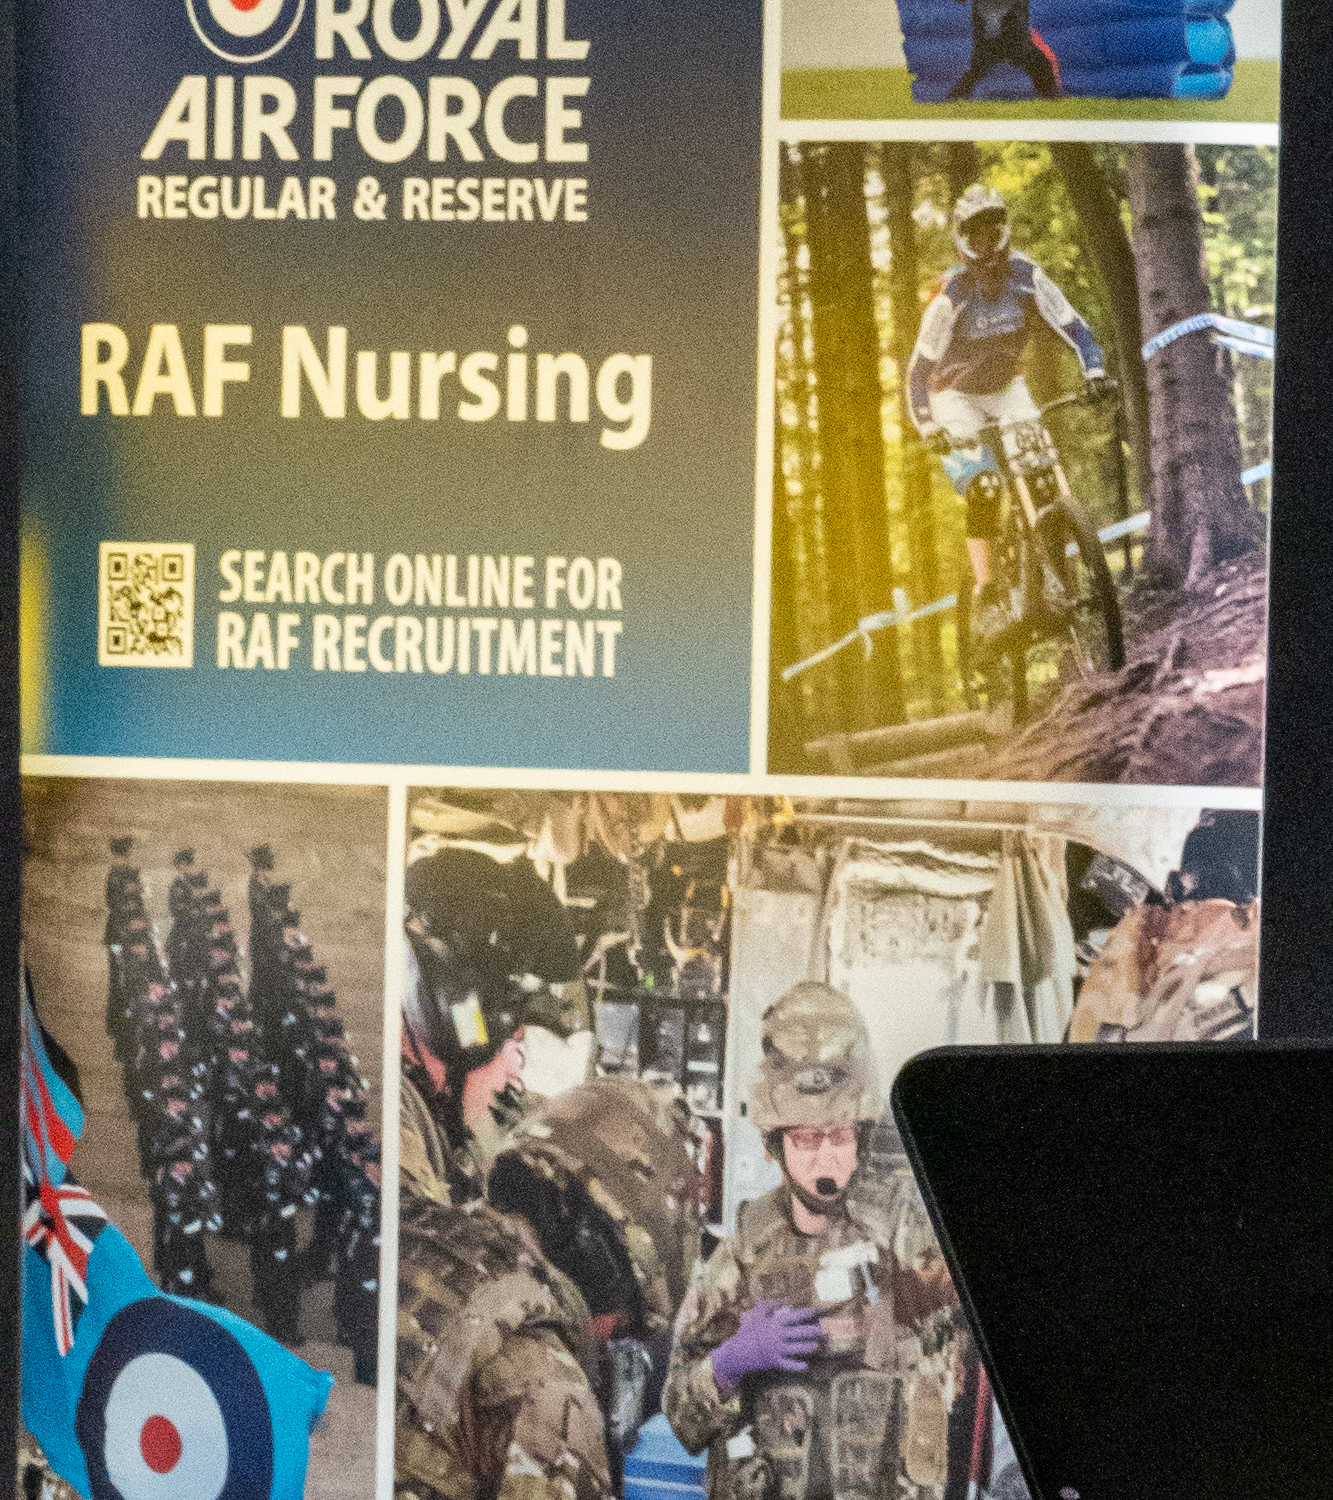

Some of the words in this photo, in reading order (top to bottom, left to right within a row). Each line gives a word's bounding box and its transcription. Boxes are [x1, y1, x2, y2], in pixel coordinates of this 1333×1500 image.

[141, 75, 299, 161] AIR
[313, 75, 591, 164] FORCE
[137, 175, 336, 220] REGULAR
[353, 176, 387, 221] &
[403, 177, 588, 222] RESERVE
[82, 323, 253, 418] RAF
[281, 325, 653, 451] Nursing
[219, 550, 374, 605] SEARCH
[384, 553, 534, 609] ONLINE
[545, 556, 623, 610] FOR
[217, 611, 300, 670] RAF
[312, 614, 623, 677] RECRUITMENT
